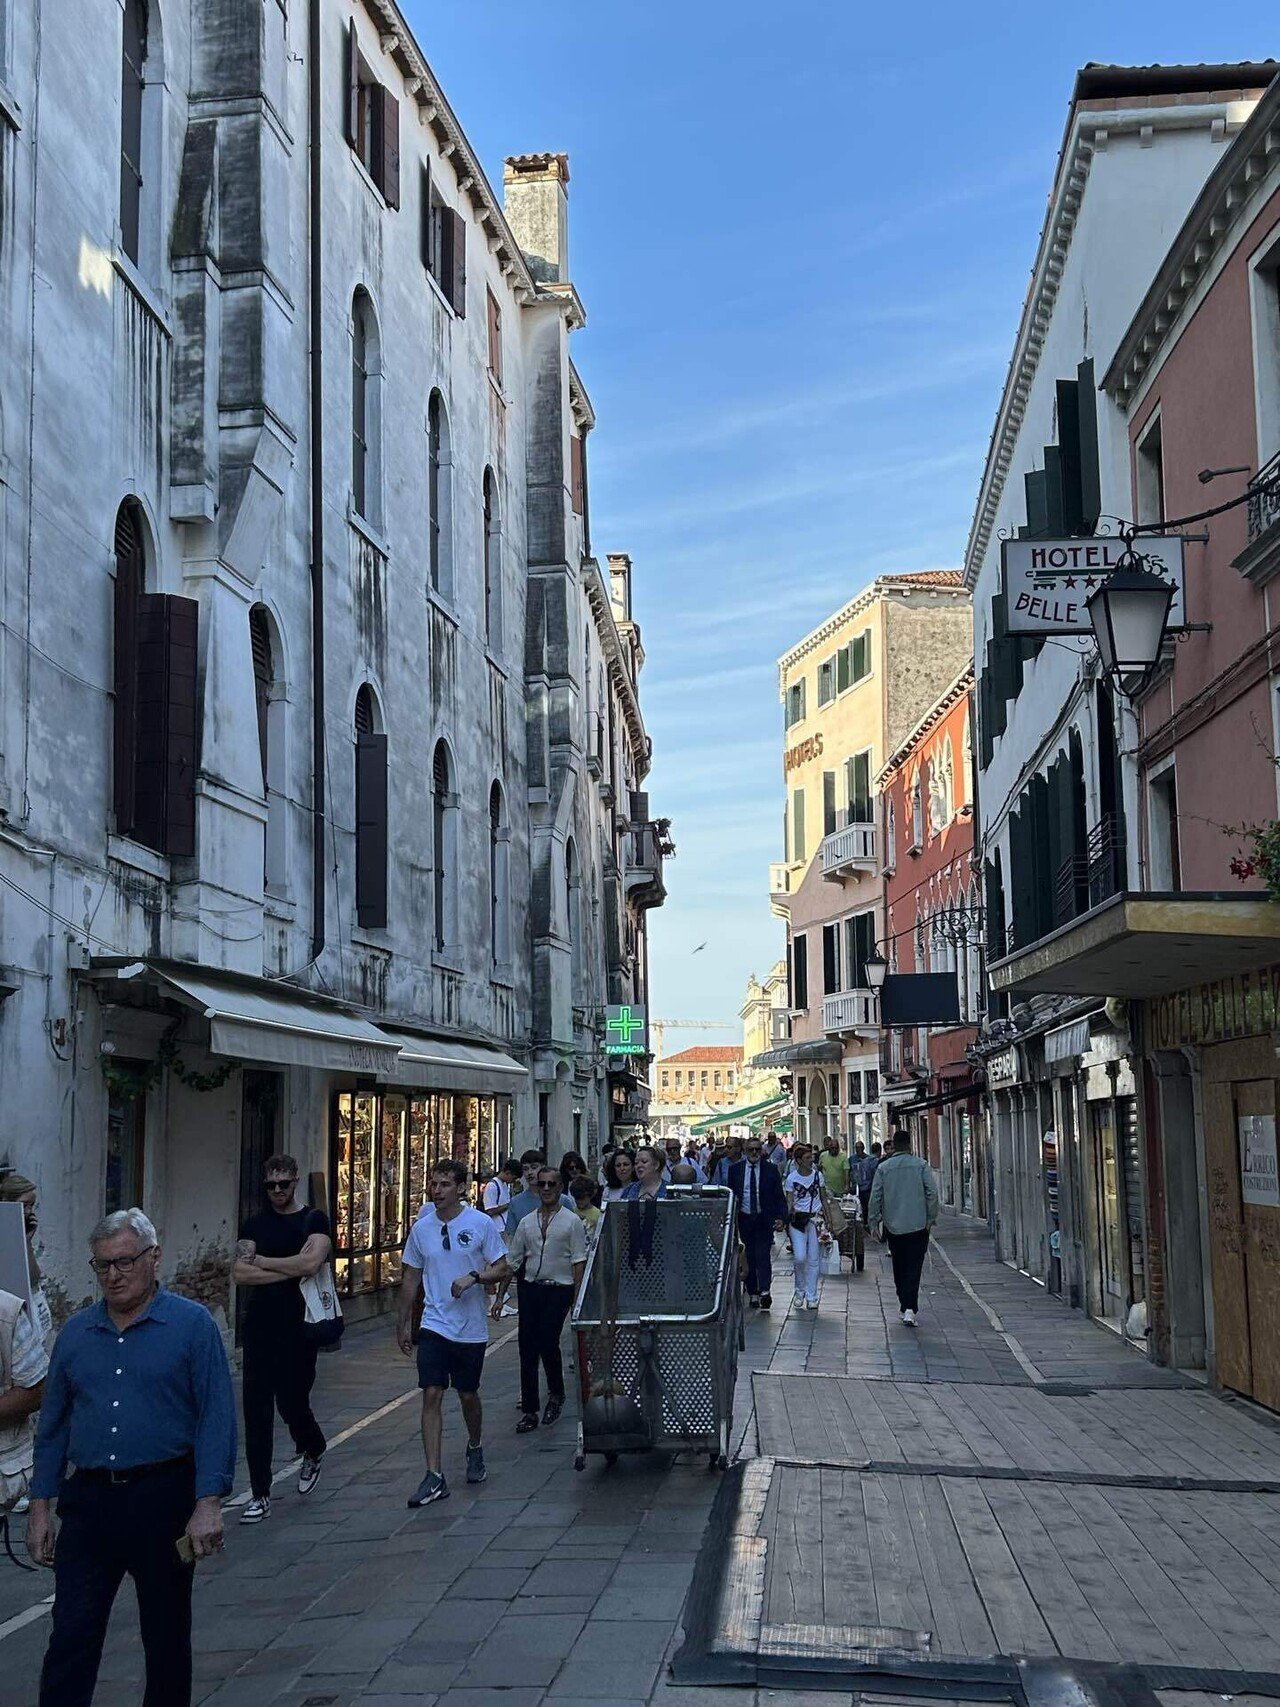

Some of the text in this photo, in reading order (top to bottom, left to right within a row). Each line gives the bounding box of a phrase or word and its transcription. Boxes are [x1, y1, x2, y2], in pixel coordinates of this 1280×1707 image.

[1032, 547, 1116, 568] HOTEL
[1015, 592, 1078, 623] BELLE
[606, 1045, 645, 1054] FARMACIA
